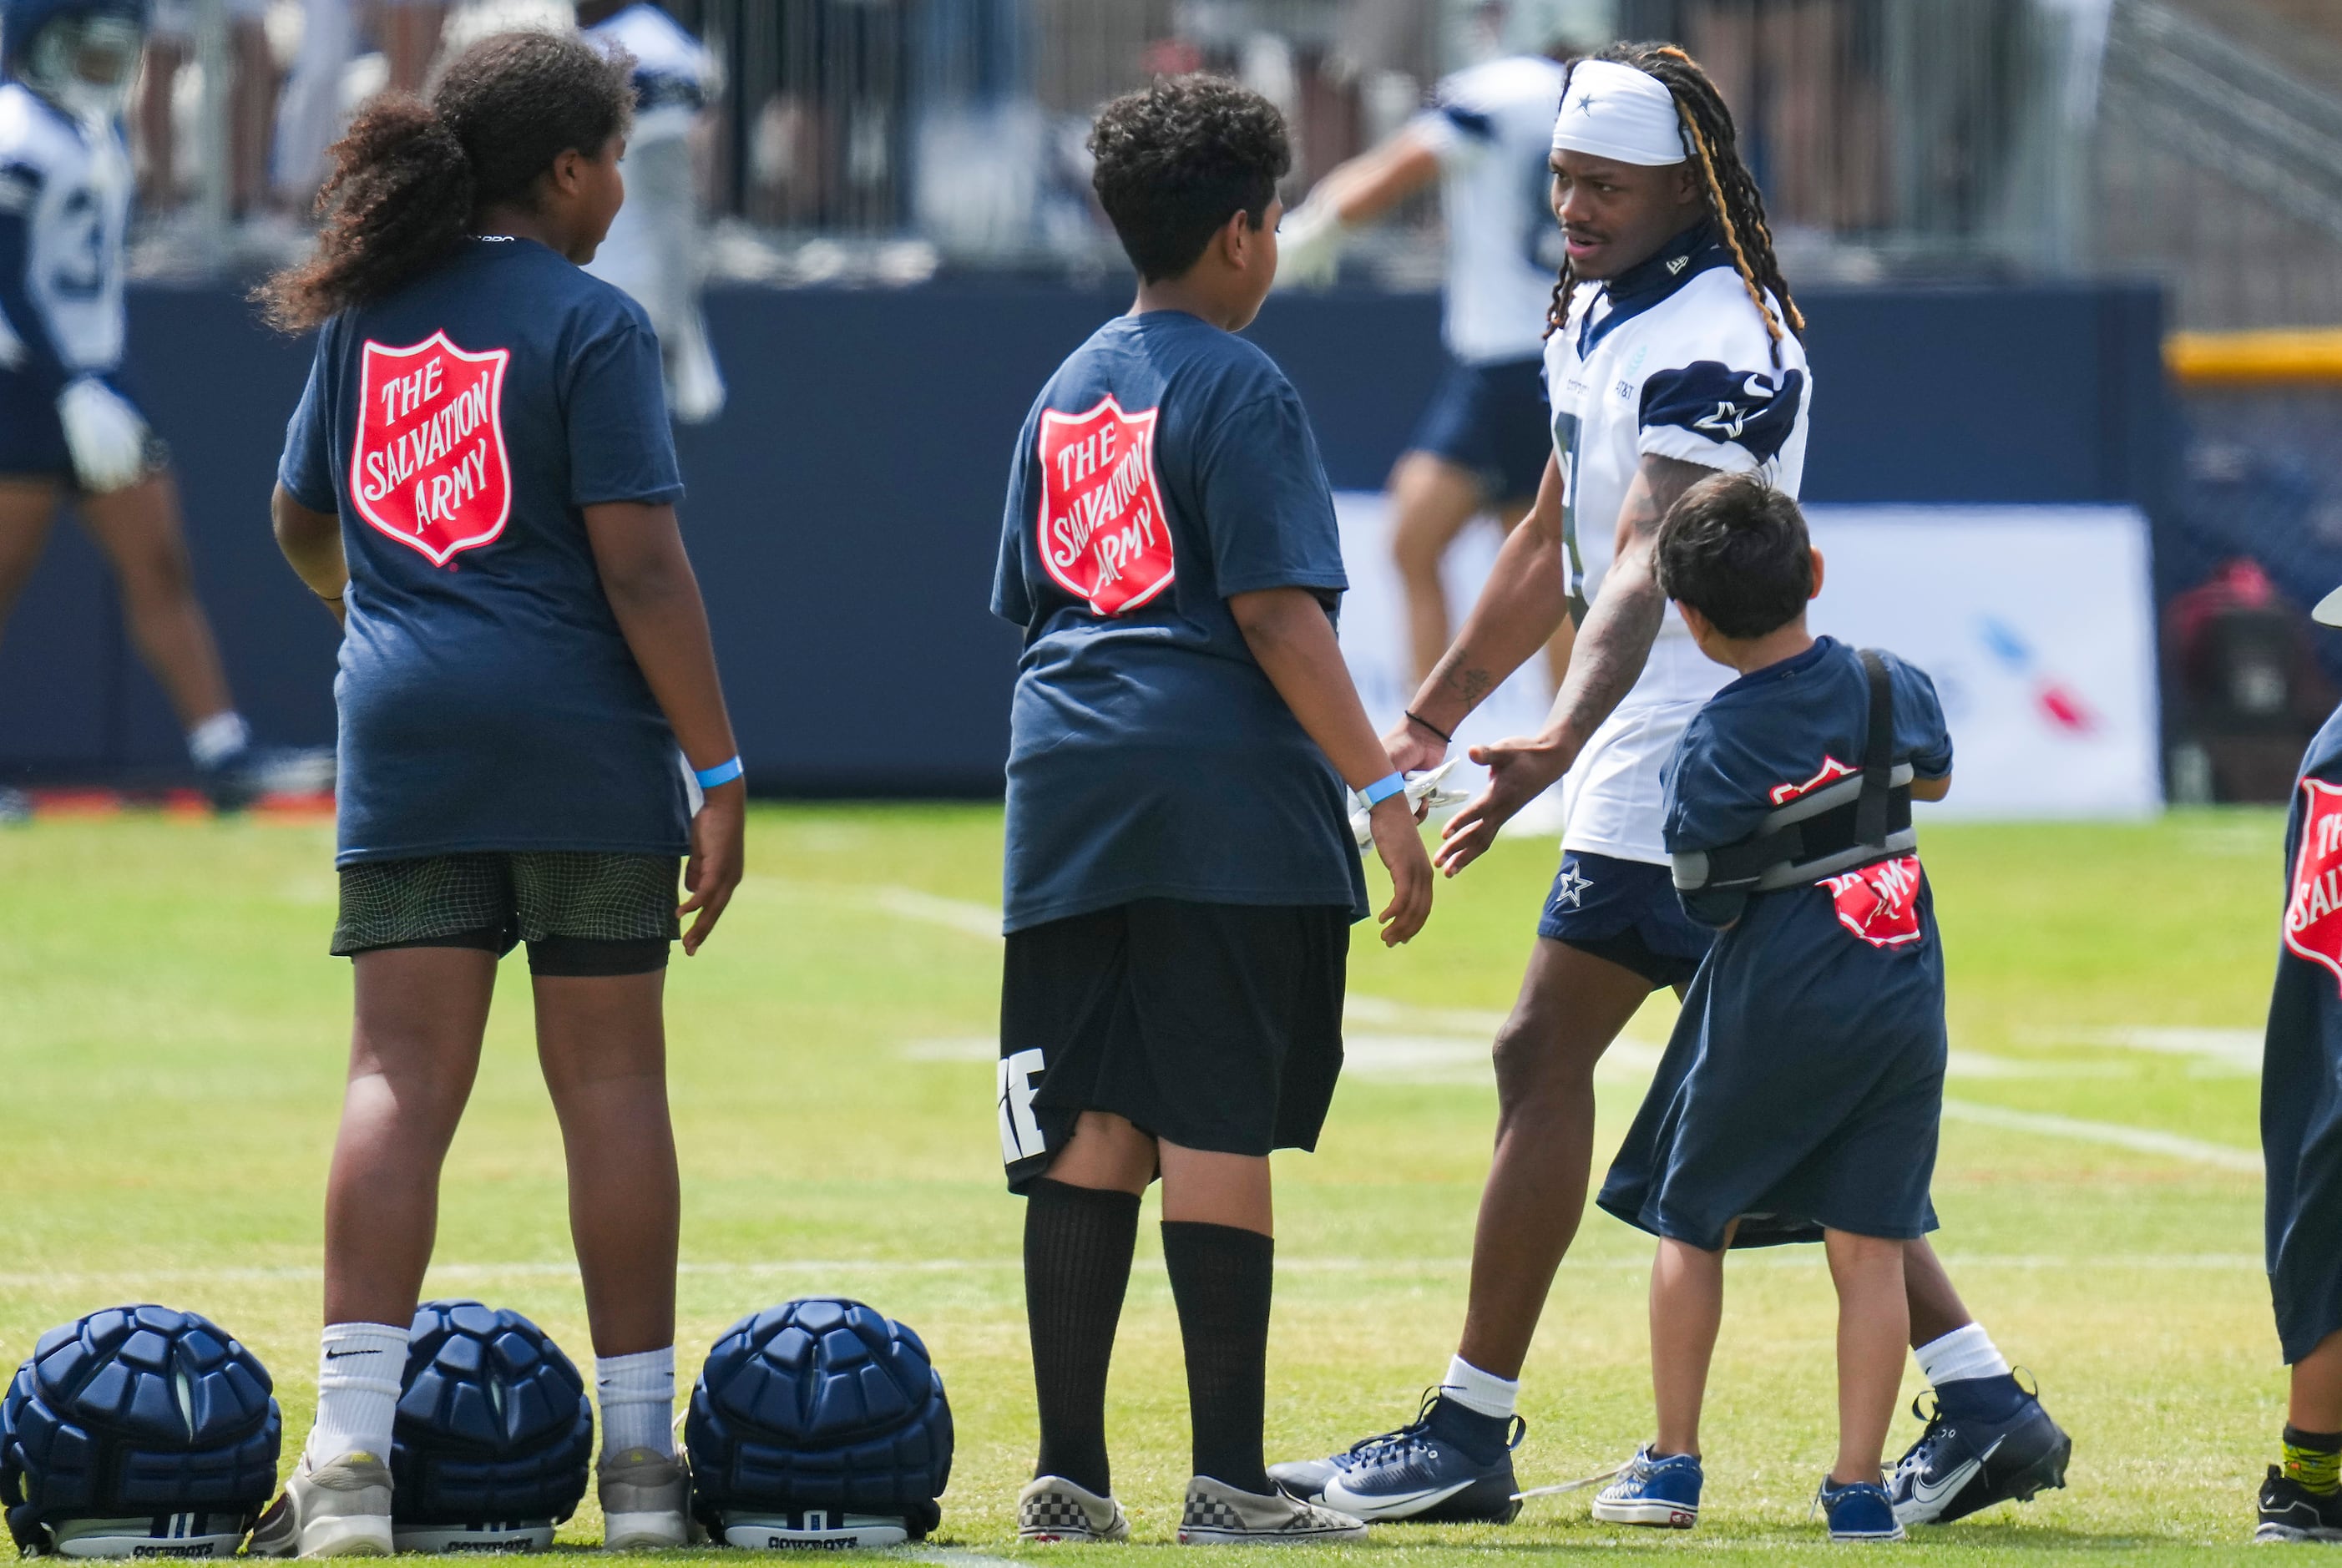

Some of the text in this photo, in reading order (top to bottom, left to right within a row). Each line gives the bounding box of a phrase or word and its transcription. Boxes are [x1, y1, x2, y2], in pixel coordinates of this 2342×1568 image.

[363, 371, 488, 502] SALVATION
[382, 356, 443, 427] THE
[416, 438, 488, 535] ARMY
[1054, 431, 1147, 567] SALVATION
[1057, 422, 1117, 492] THE
[1091, 496, 1156, 598] ARMY
